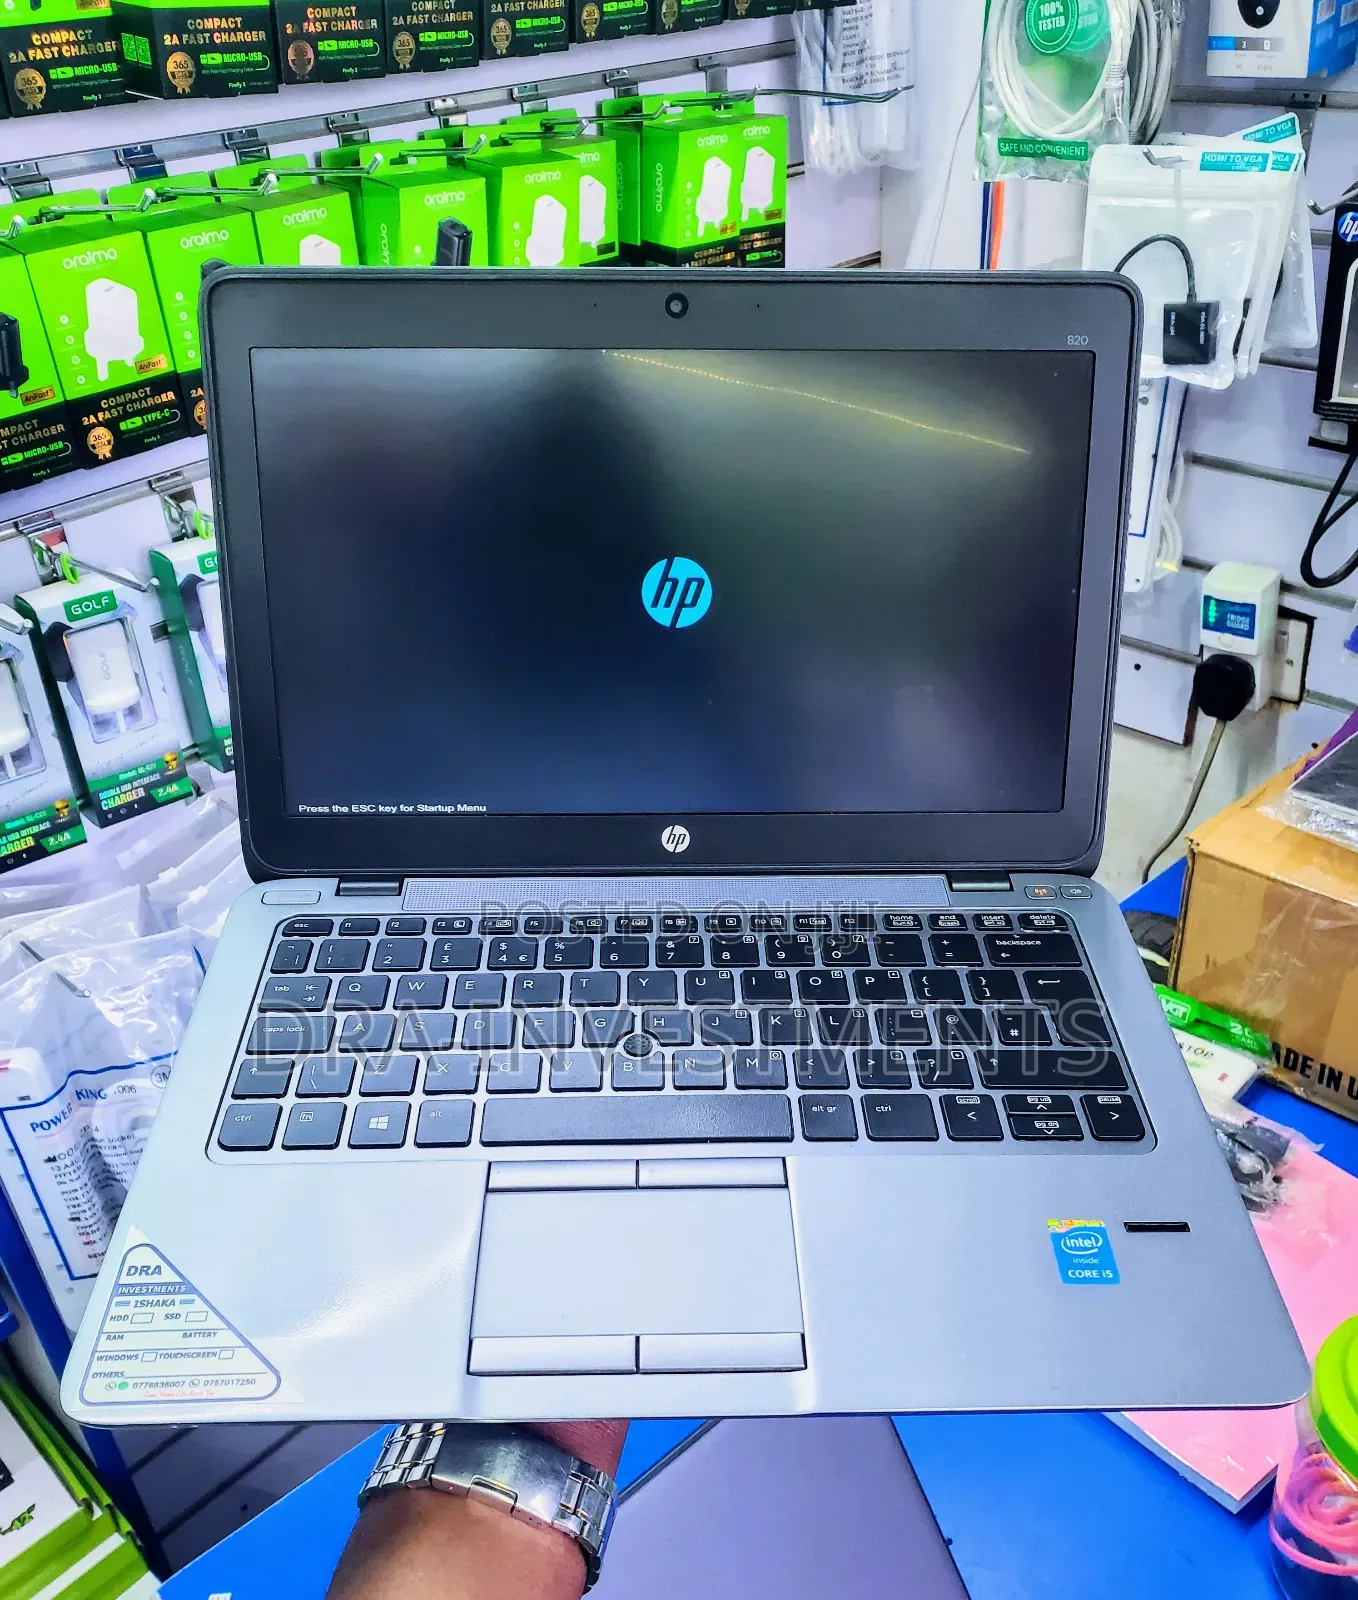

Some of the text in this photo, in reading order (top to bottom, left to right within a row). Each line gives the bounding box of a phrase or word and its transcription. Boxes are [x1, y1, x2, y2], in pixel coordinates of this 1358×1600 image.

[411, 0, 456, 11] COMPACT
[491, 3, 503, 13] 2A
[504, 1, 526, 12] FAST
[1039, 1, 1064, 17] 100%
[306, 6, 357, 19] COMPACT
[186, 17, 243, 30] COMPACT
[392, 11, 473, 26] 2A FAST CHARGER
[1038, 16, 1065, 31] TESTED
[302, 21, 329, 33] FAST
[331, 18, 378, 31] CHARGER
[495, 26, 508, 34] 365
[31, 28, 93, 46] COMPACT
[163, 30, 266, 45] 2A FAST CHARGER
[437, 30, 469, 40] MICRO-USB
[338, 38, 374, 49] MICRO-USB
[397, 39, 411, 47] 365
[8, 50, 26, 63] 2A
[27, 46, 59, 60] FAST
[223, 52, 263, 62] MICRO-USB
[74, 62, 118, 76] MICRO-USB
[173, 60, 189, 69] 365
[21, 77, 38, 86] 365
[1265, 127, 1276, 136] TO
[1276, 120, 1292, 132] VGA
[697, 133, 728, 148] oraimo
[1000, 142, 1086, 156] SAFE AND CONVENIENT
[1204, 153, 1263, 163] HDMI TO VGA
[524, 169, 562, 185] oraimo
[655, 162, 664, 212] oraimo
[424, 190, 466, 206] oraimo
[283, 207, 328, 227] oraimo
[180, 228, 229, 250] oraimo
[62, 247, 118, 270] oraimo
[1067, 335, 1089, 346] 820
[24, 389, 50, 402] AniFast
[100, 387, 151, 408] COMPACT
[190, 387, 204, 398] 2A
[82, 391, 175, 425] 2A FAST CHARGER
[143, 408, 170, 423] TYPE-C
[0, 419, 38, 437] MPACT
[12, 424, 65, 446] CHARGER
[92, 432, 107, 442] 365
[23, 441, 64, 458] MICRO-USB
[645, 557, 709, 629] hp
[71, 595, 110, 616] GOLF
[99, 787, 120, 800] DOUBLE
[158, 784, 179, 796] 2.4A
[101, 787, 146, 811] CHARGER
[299, 804, 487, 815] Press the ESC key for Startup Menu
[48, 831, 71, 846] 2.4A
[662, 824, 690, 854] hp
[0, 836, 36, 857] ARGER
[326, 956, 332, 964] 1
[498, 954, 508, 962] 4
[666, 952, 674, 960] 7
[721, 952, 731, 960] 8
[776, 951, 786, 959] 9
[408, 981, 426, 990] W
[465, 981, 475, 989] E
[523, 981, 534, 989] R
[580, 979, 590, 988] T
[638, 978, 650, 987] Y
[696, 977, 706, 986] U
[809, 977, 822, 986] O
[865, 977, 875, 985] P
[274, 984, 289, 992] tab
[349, 983, 361, 992] Q
[474, 1020, 486, 1030] D
[534, 1019, 544, 1028] F
[595, 1018, 606, 1028] G
[653, 1017, 665, 1027] H
[711, 1016, 720, 1026] J
[771, 1015, 781, 1025] K
[829, 1015, 839, 1025] L
[263, 1025, 306, 1034] caps lock
[353, 1022, 365, 1032] A
[414, 1021, 424, 1031] S
[437, 1063, 449, 1073] X
[500, 1063, 512, 1072] C
[563, 1060, 575, 1071] V
[623, 1062, 634, 1072] B
[684, 1058, 696, 1069] N
[746, 1058, 759, 1068] M
[1271, 1042, 1314, 1079] ADE
[1318, 1063, 1343, 1092] IN
[374, 1064, 385, 1075] Z
[30, 1088, 107, 1133] POWER KING
[811, 1104, 837, 1113] alt gr
[875, 1104, 892, 1112] ctrl
[234, 1114, 252, 1122] ctrl
[429, 1110, 442, 1118] alt
[1066, 1236, 1097, 1248] intel
[1072, 1256, 1100, 1264] inside
[126, 1264, 162, 1277] DRA
[1068, 1269, 1113, 1278] CORE i5
[118, 1285, 187, 1294] INVESTMENTS
[133, 1299, 176, 1308] ISHAKA
[109, 1314, 130, 1322] HDD
[182, 1331, 218, 1339] BATTERY
[96, 1351, 217, 1362] WINDOWS TOUCHSCREEN
[92, 1371, 125, 1379] OTHERS
